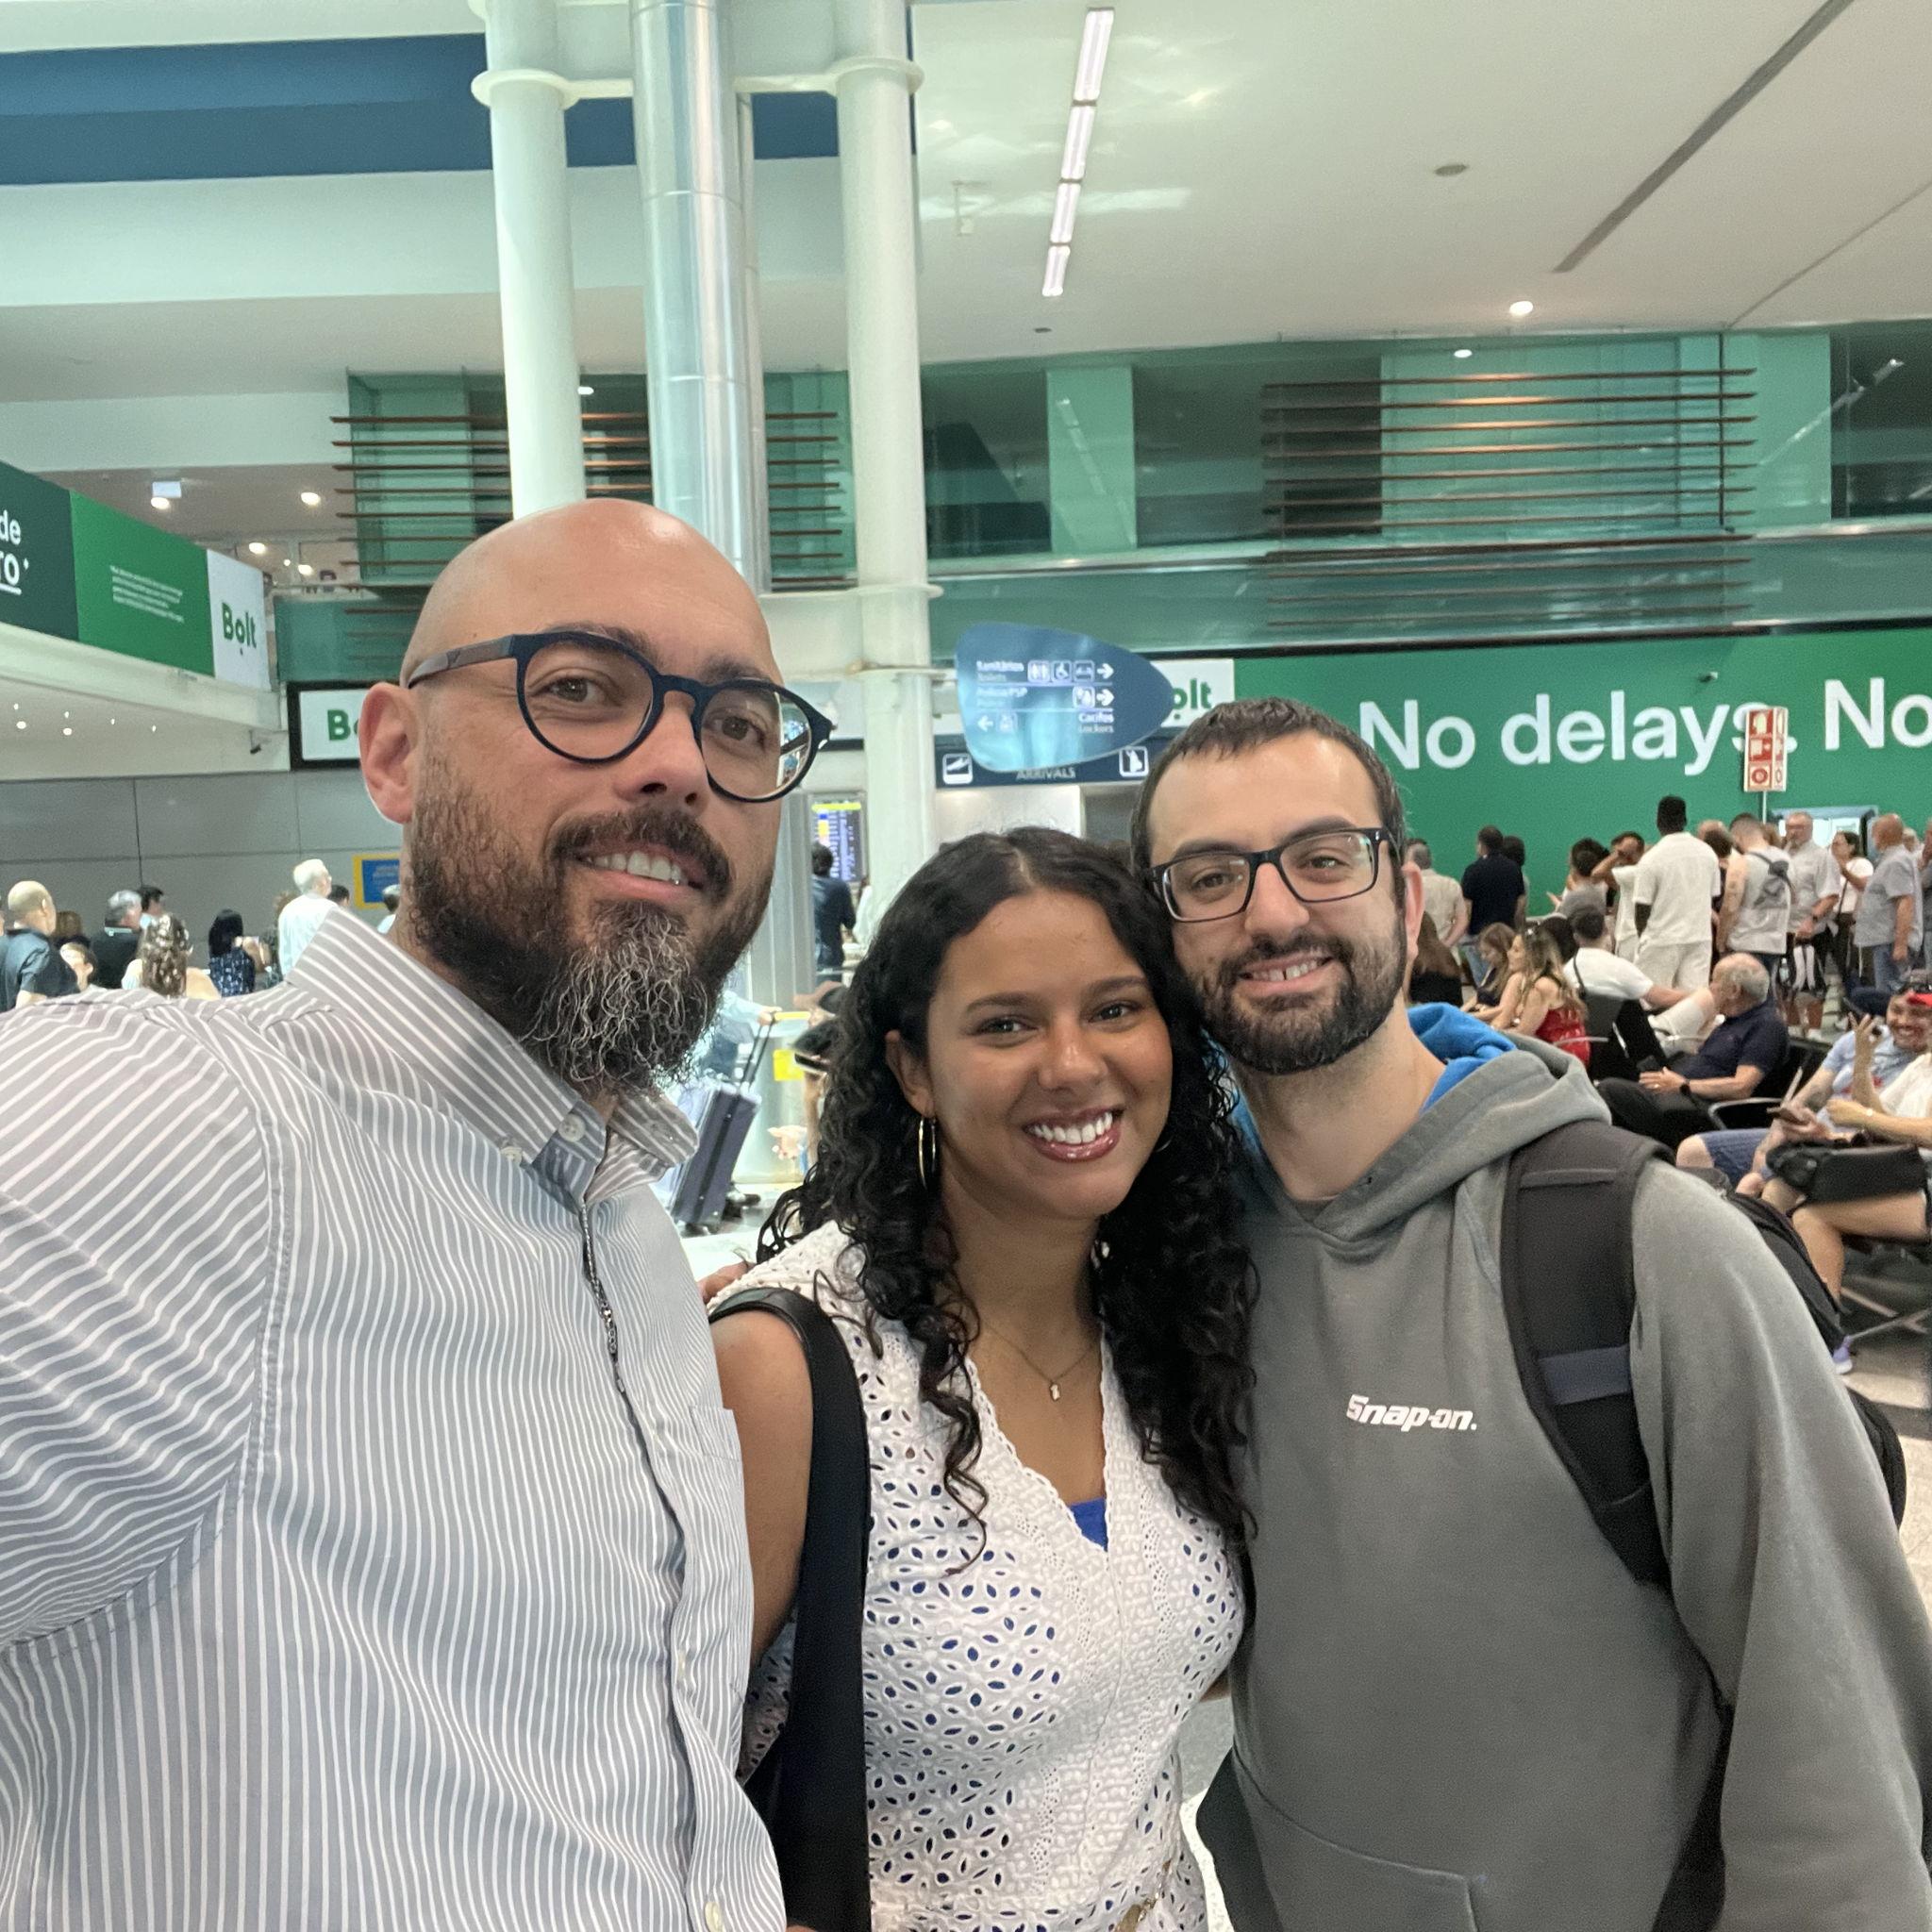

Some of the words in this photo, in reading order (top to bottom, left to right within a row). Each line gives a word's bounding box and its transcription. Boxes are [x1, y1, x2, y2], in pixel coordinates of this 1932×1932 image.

[222, 602, 257, 656] Bolt
[1173, 678, 1211, 720] olt
[327, 709, 358, 741] B
[1359, 699, 1475, 770] No
[1824, 677, 1932, 750] No
